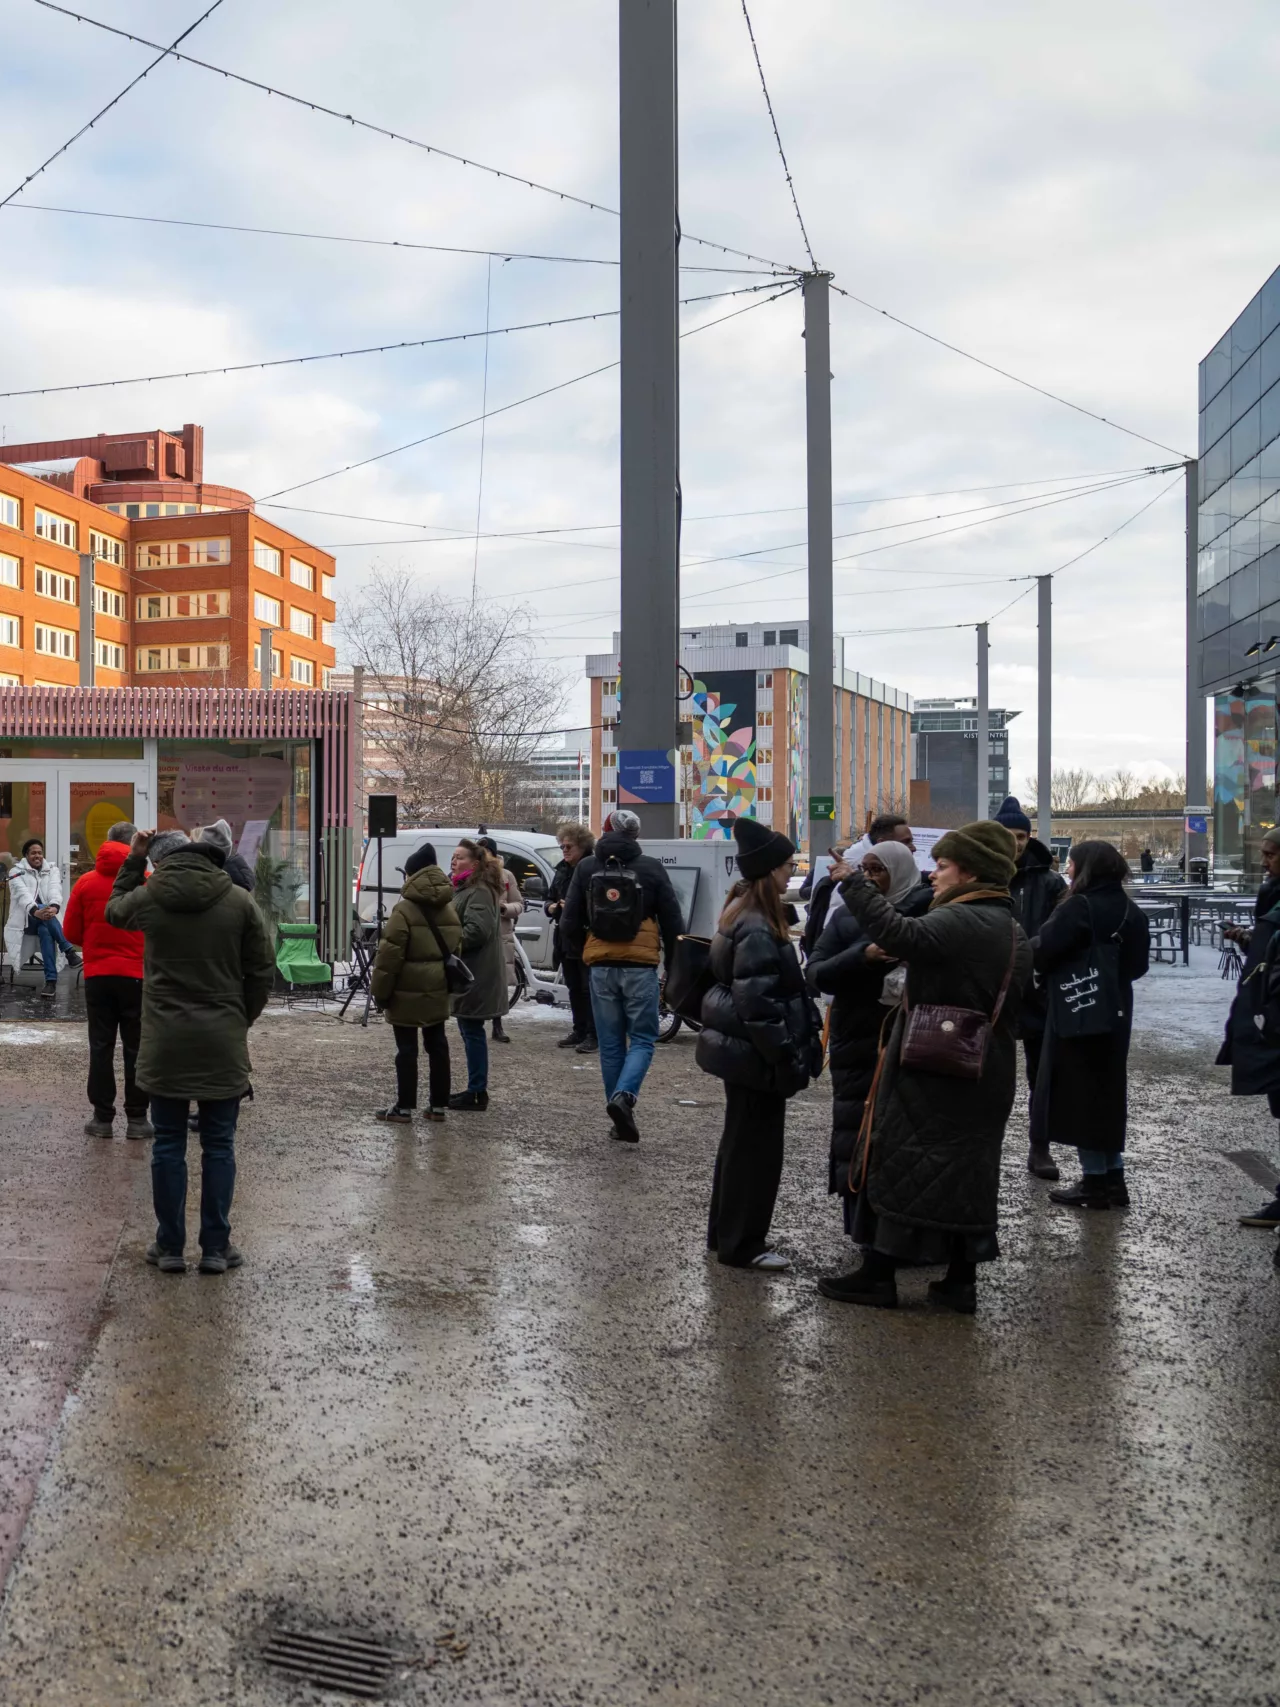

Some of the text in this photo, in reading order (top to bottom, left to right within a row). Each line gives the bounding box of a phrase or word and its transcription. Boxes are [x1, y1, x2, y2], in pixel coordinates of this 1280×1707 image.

[212, 764, 224, 772] du
[1060, 967, 1099, 990] فلسطين
[1065, 983, 1099, 1002] فلسطين
